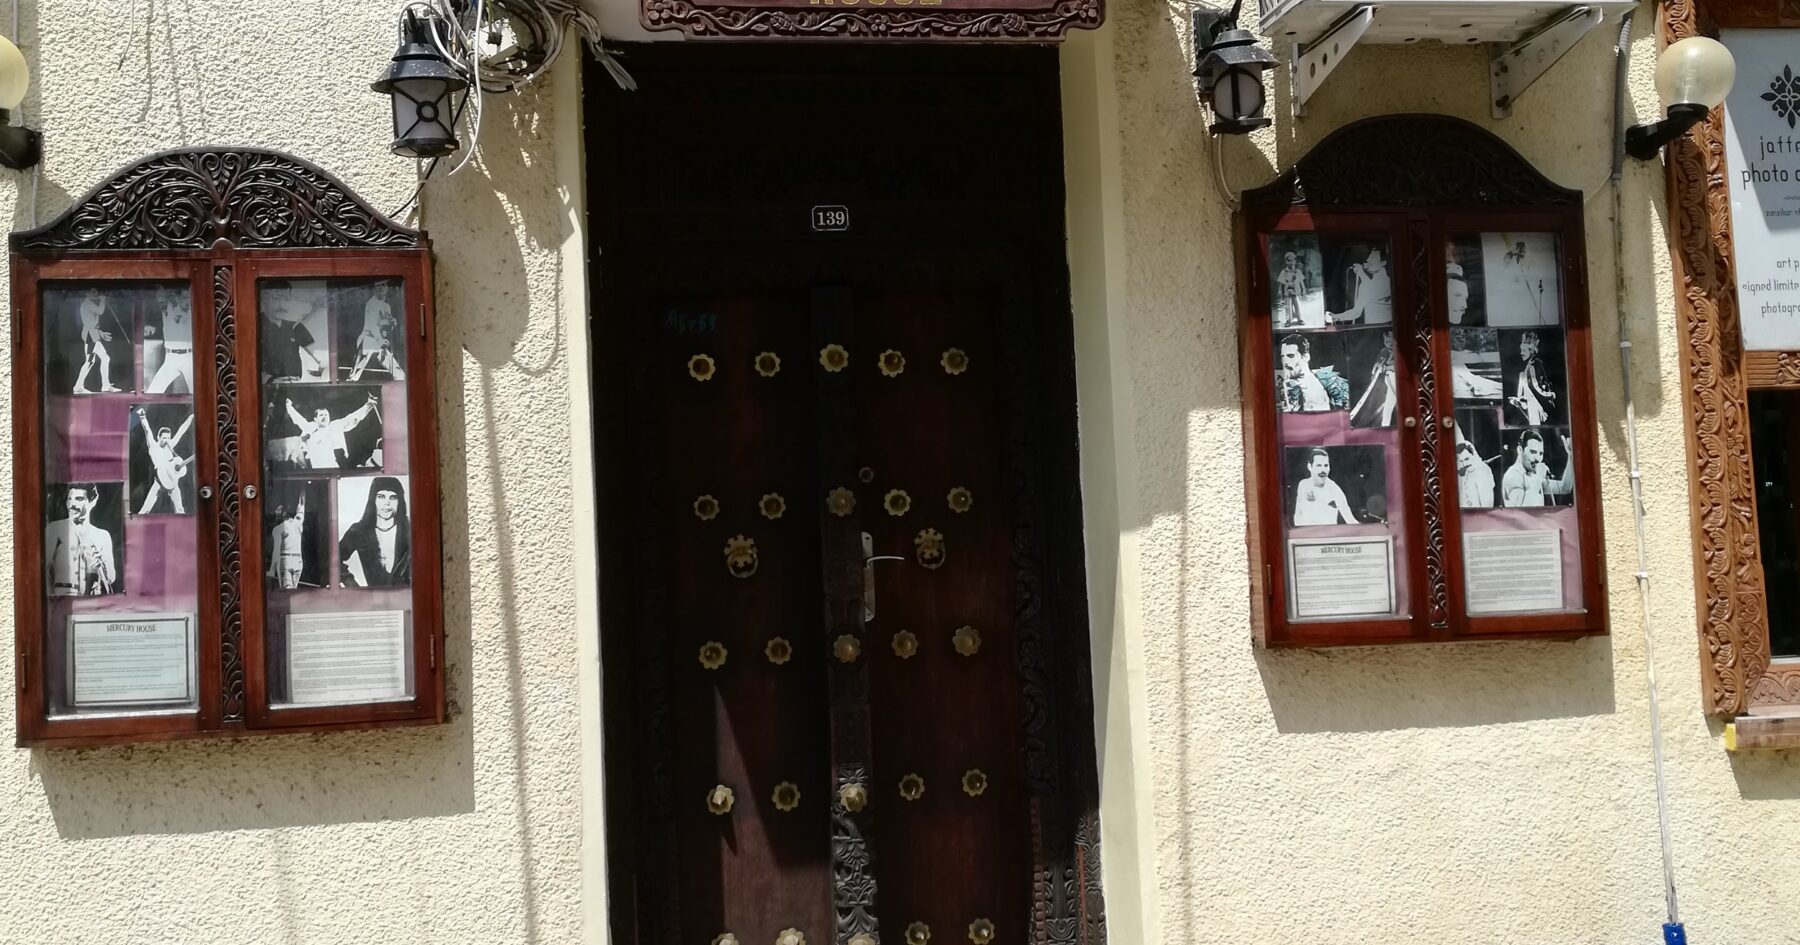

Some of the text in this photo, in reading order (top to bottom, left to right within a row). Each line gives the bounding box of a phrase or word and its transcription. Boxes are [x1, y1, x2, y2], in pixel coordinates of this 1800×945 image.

[1741, 162, 1788, 190] photo
[816, 211, 845, 225] 139
[1776, 257, 1791, 268] art
[106, 624, 157, 633] MERCURY HOUSE
